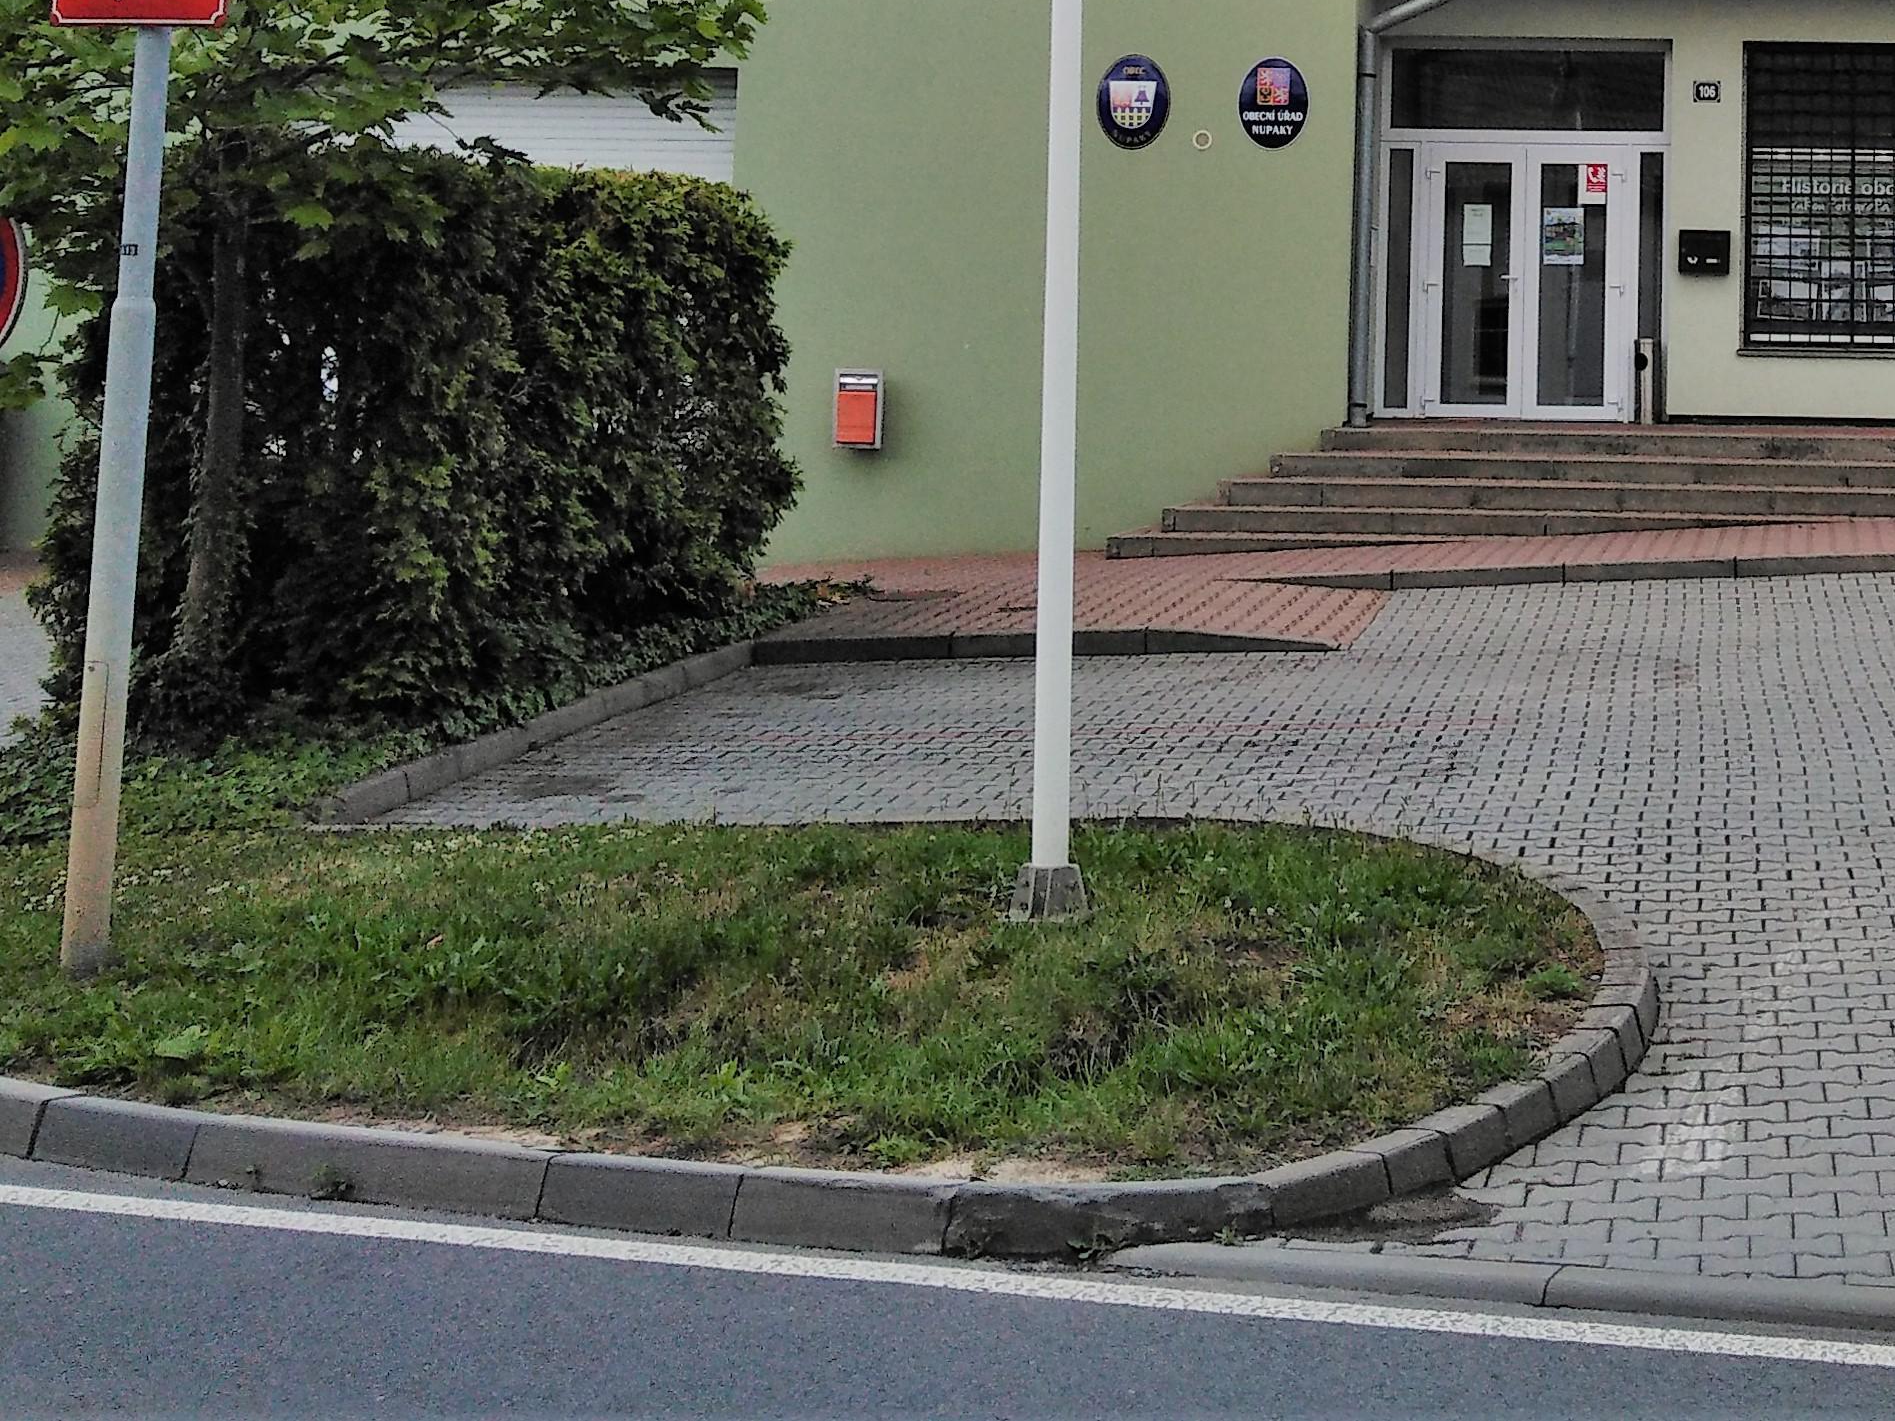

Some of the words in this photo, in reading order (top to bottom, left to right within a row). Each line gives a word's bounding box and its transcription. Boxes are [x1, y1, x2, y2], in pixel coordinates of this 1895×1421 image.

[1698, 85, 1716, 98] 106
[1242, 109, 1275, 121] OBECNÍ
[1277, 109, 1304, 121] ÚŘAD
[1251, 124, 1293, 135] NUPAKY
[1781, 179, 1852, 195] Historie
